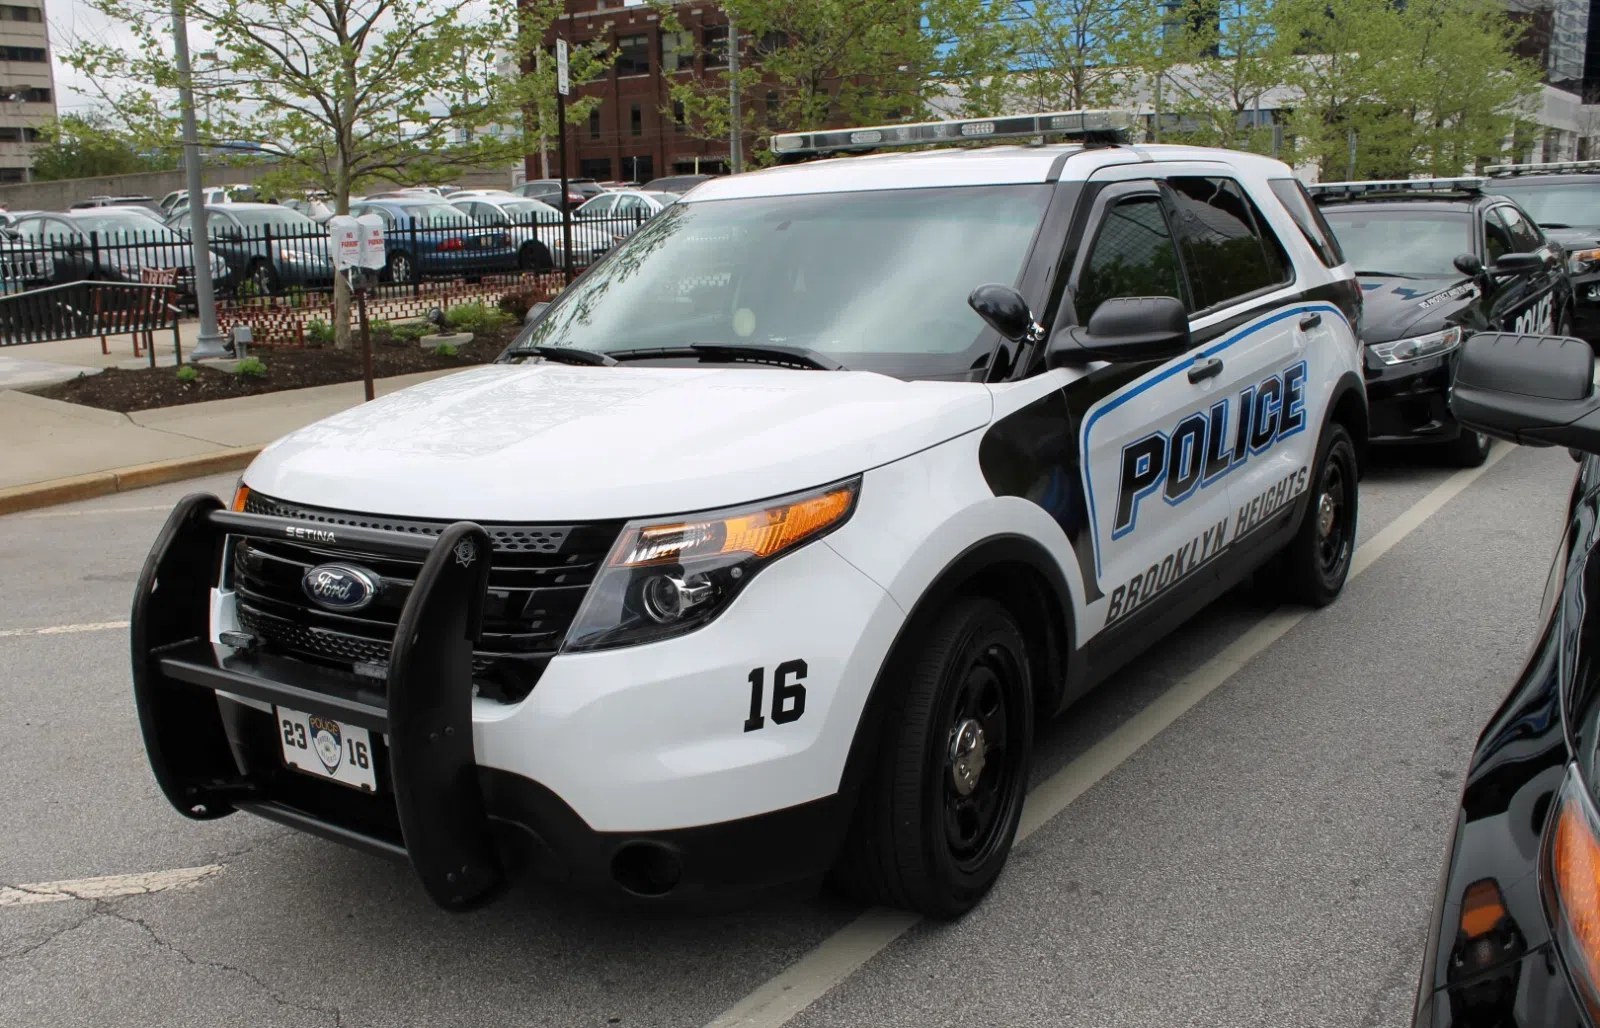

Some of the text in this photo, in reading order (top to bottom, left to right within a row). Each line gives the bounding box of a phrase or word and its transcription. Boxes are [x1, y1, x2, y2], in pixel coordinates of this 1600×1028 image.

[1427, 290, 1451, 304] PROTECT
[1111, 360, 1307, 541] POLICE
[285, 526, 337, 543] SETINA
[1104, 465, 1308, 627] BROOKLYN HEIGHTS
[313, 571, 352, 599] Ford
[743, 658, 808, 733] 16
[282, 719, 308, 750] 23
[310, 717, 340, 736] POLICE
[346, 738, 369, 769] 16
